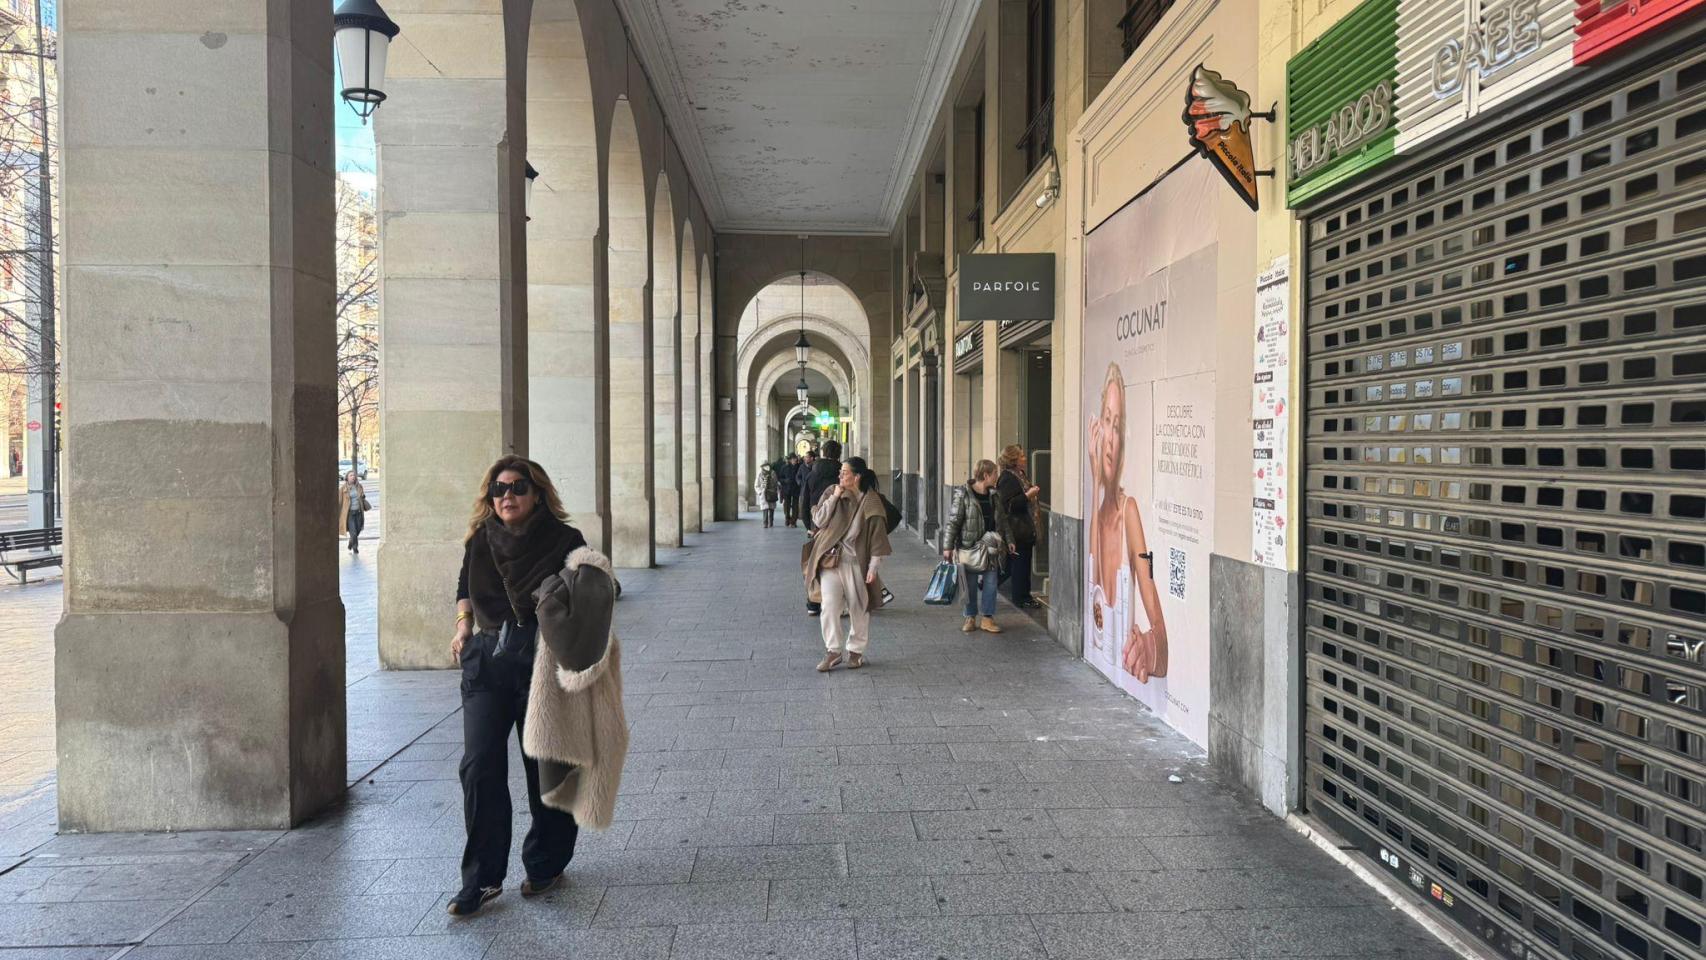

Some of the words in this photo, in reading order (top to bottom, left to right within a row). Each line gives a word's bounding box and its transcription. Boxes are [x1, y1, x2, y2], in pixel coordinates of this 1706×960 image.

[1287, 81, 1391, 177] HELADOS
[1218, 141, 1238, 166] Piccola
[973, 281, 1040, 292] PARFOIS
[1116, 300, 1167, 341] COCUNAT
[1167, 405, 1193, 418] DESCUBRE
[1155, 424, 1162, 436] LA
[1192, 424, 1206, 439] CON
